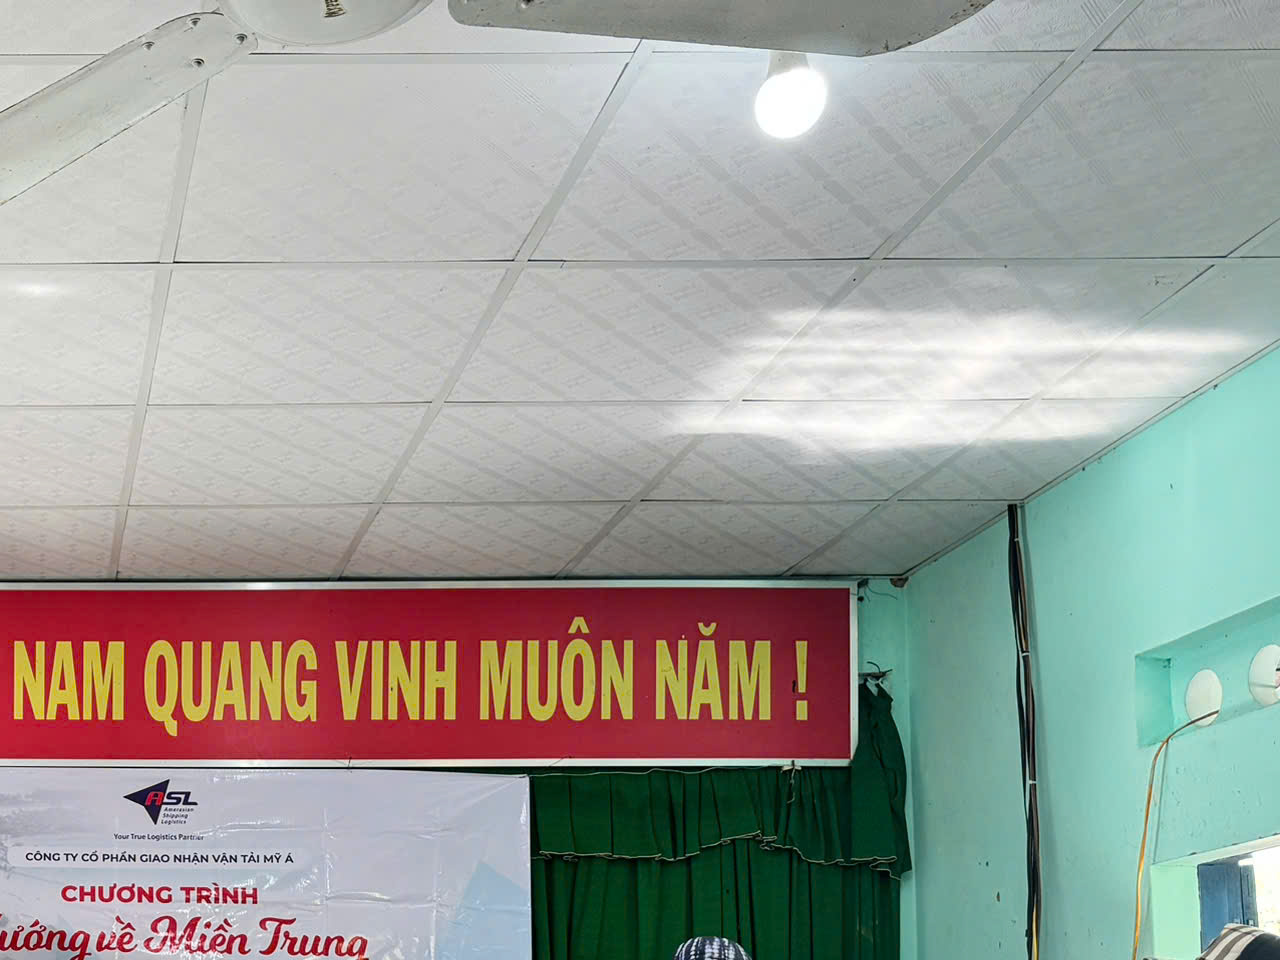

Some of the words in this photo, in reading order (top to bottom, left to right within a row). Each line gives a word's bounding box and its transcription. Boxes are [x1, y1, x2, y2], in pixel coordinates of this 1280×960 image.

[15, 641, 125, 721] NAM
[144, 639, 318, 737] QUANG
[335, 640, 457, 720] VINH
[480, 616, 633, 721] MUÔN
[655, 622, 772, 721] NĂM
[795, 640, 809, 721] !
[145, 791, 198, 806] ASL
[147, 833, 177, 842] Logistics
[25, 850, 61, 862] CÔNG
[64, 852, 79, 862] TY
[140, 853, 170, 863] GIAO
[173, 851, 209, 866] NHẬN
[212, 852, 238, 866] VẬN
[263, 852, 282, 864] MỸ
[284, 852, 294, 864] Á
[61, 883, 173, 904] CHƯƠNG
[180, 882, 259, 905] TRÌNH
[95, 915, 138, 953] về
[144, 915, 251, 957] Miền
